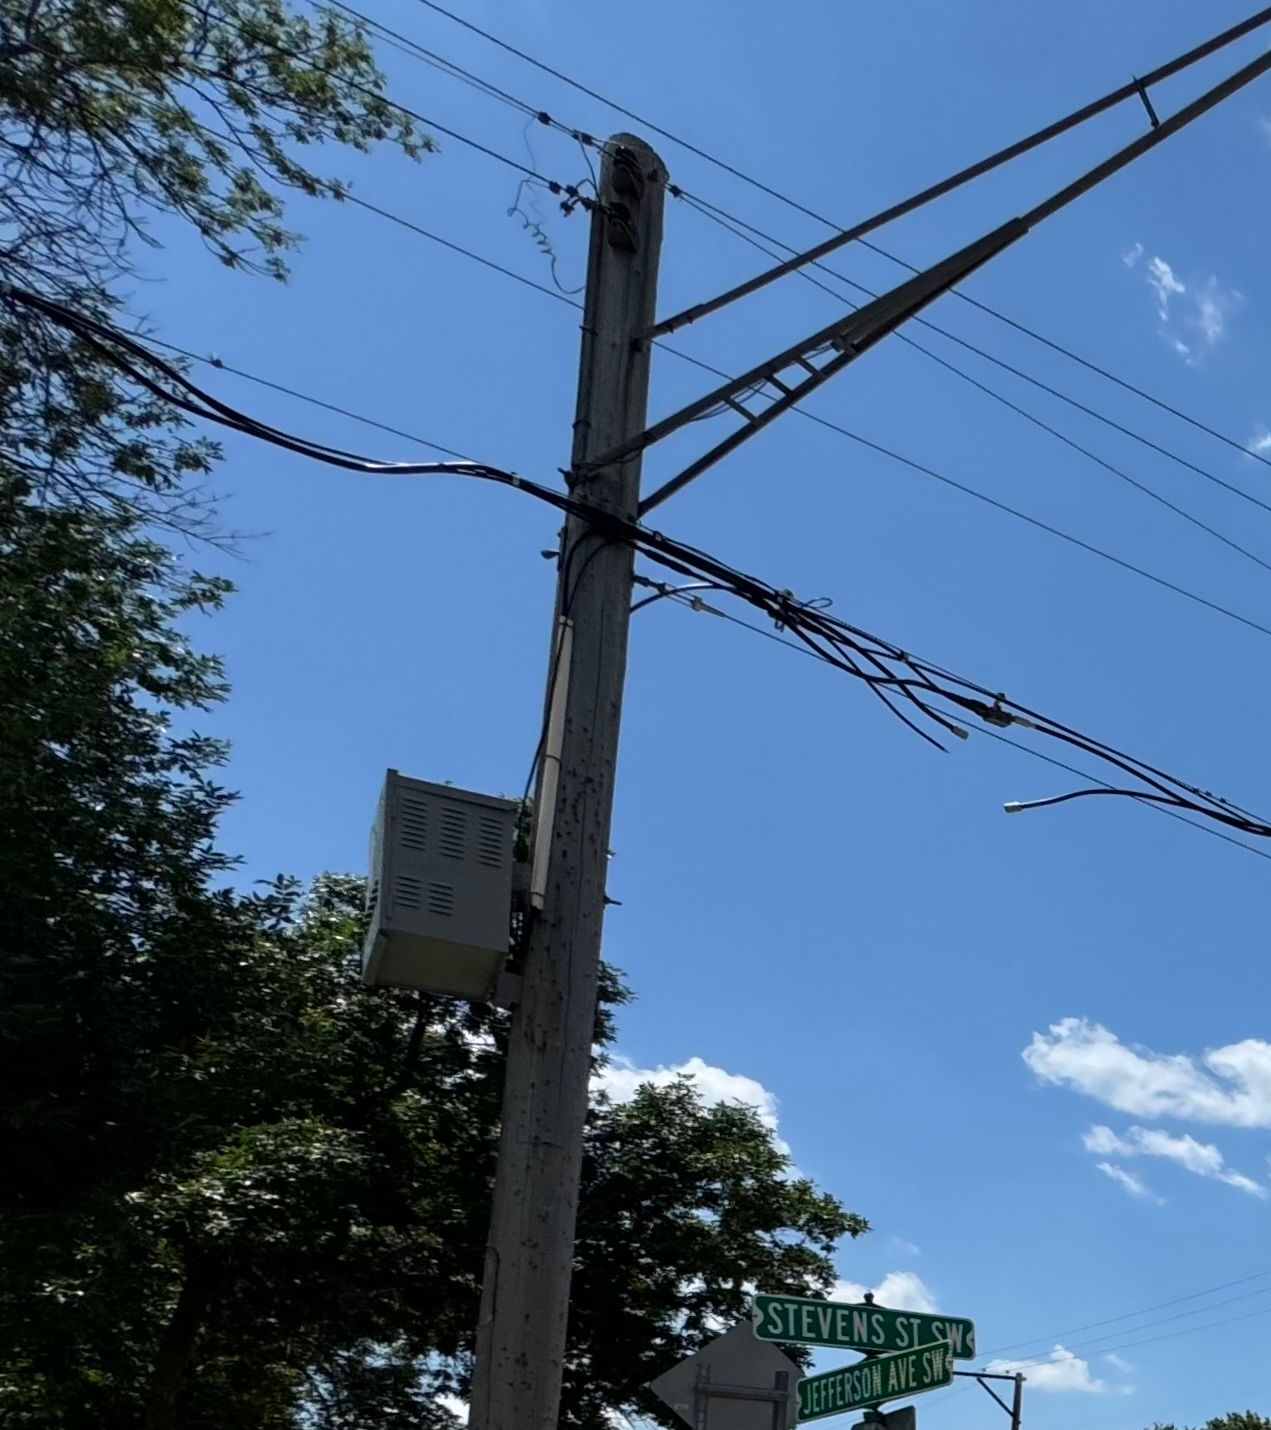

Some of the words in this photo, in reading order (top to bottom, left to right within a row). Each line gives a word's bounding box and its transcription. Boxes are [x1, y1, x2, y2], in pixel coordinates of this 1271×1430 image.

[767, 1302, 886, 1345] STEVENS
[895, 1316, 921, 1347] ST
[931, 1321, 964, 1353] SW
[803, 1364, 882, 1415] JEFFERSON
[888, 1355, 917, 1393] AVE
[922, 1347, 946, 1384] SW
